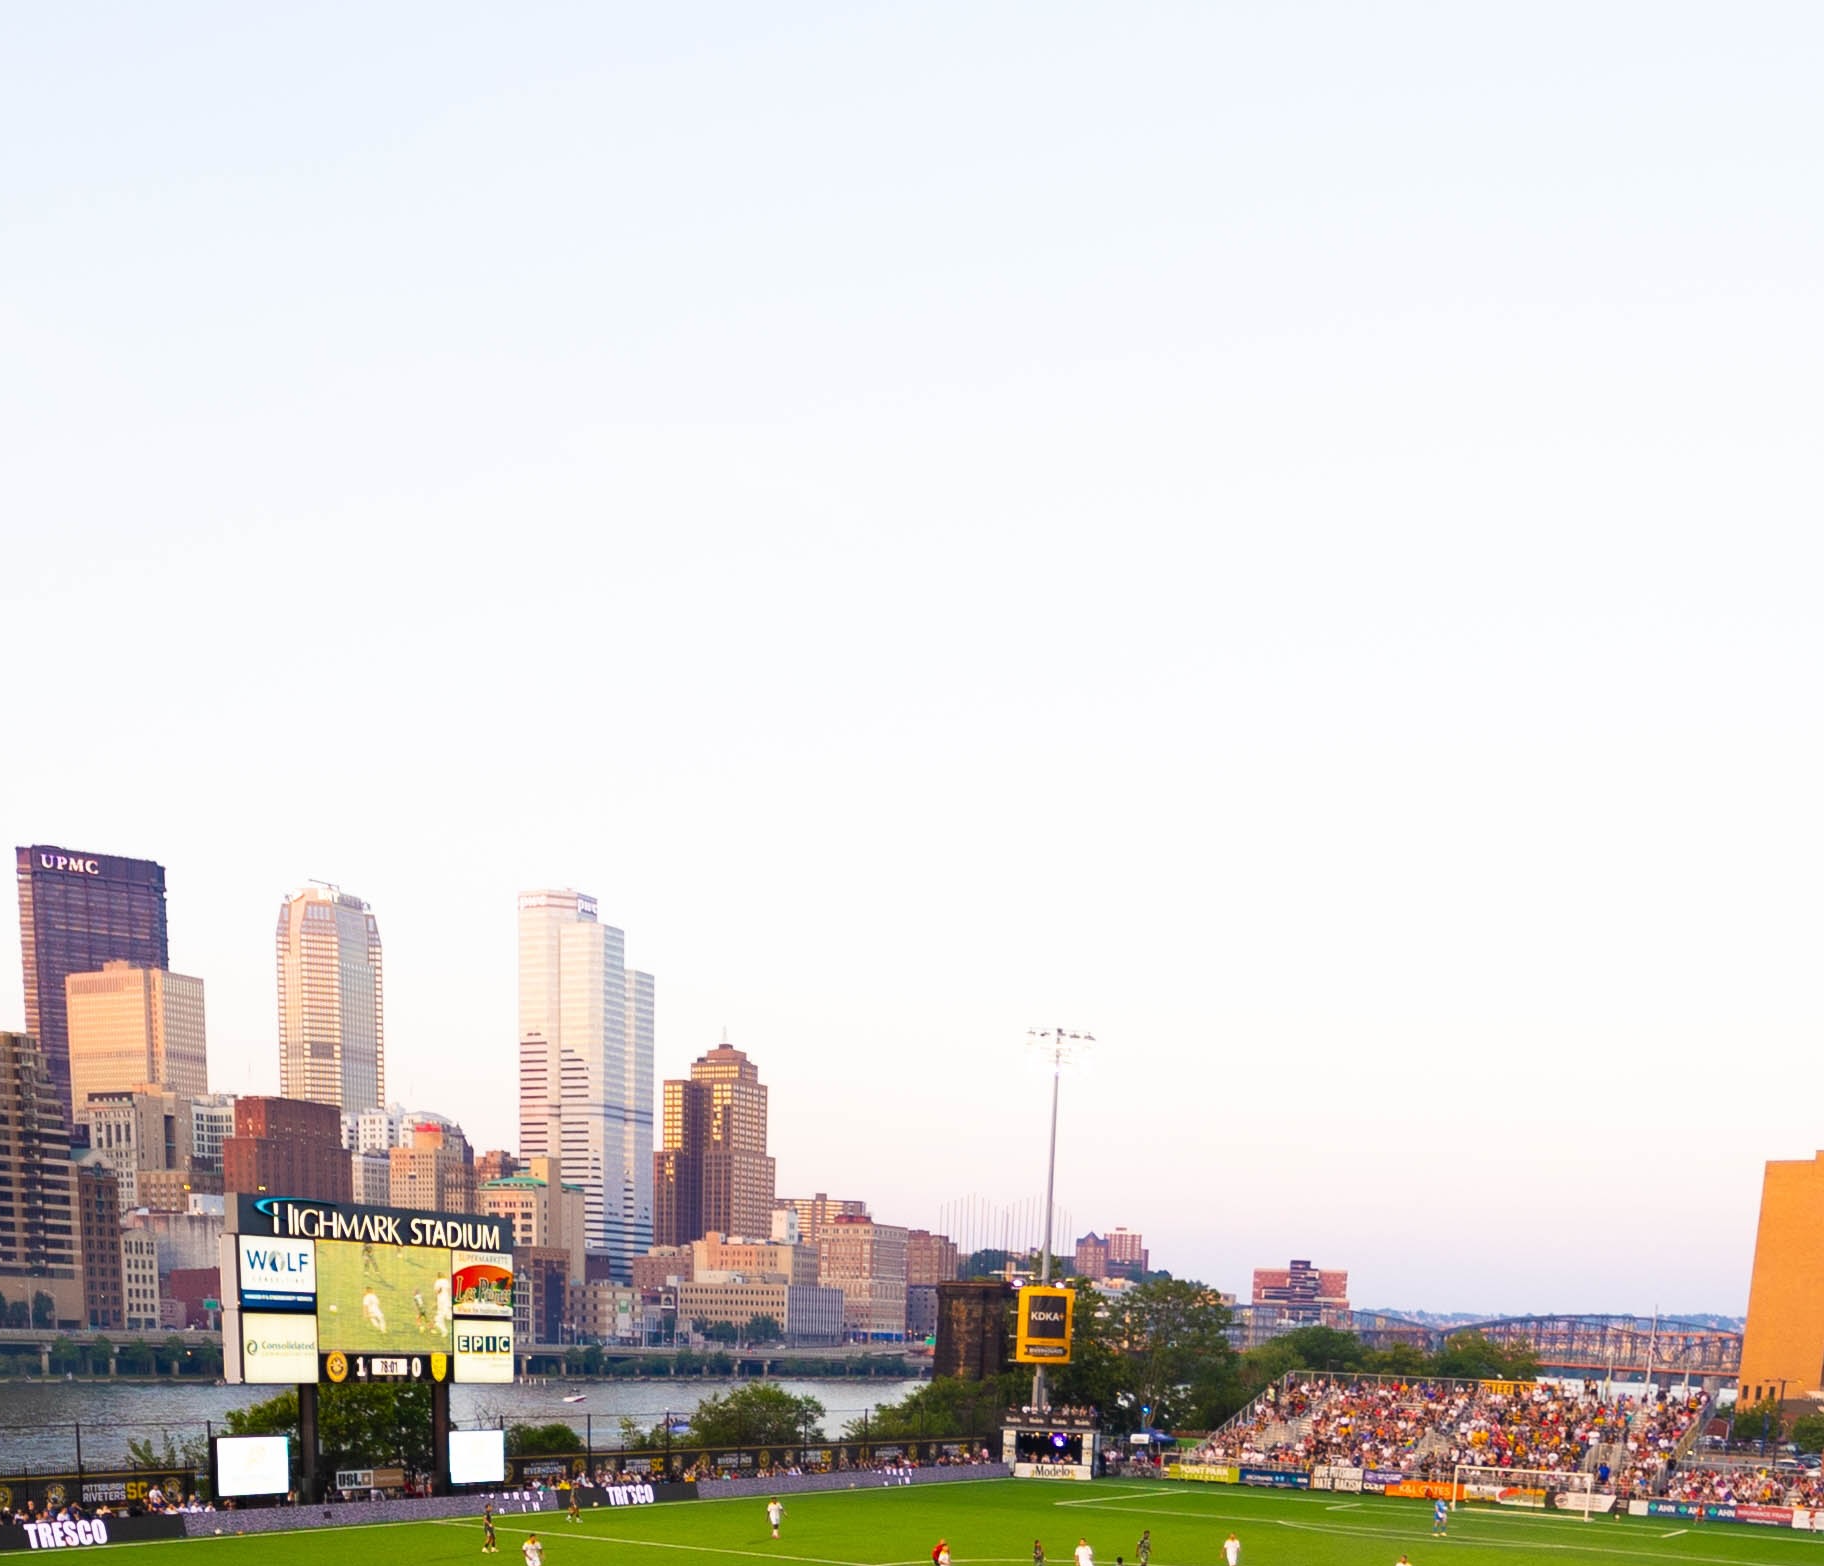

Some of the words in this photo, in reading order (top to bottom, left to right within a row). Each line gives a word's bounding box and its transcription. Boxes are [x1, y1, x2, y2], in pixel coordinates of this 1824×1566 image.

[40, 853, 99, 875] UPMC
[271, 1200, 403, 1246] HIGHMARK
[410, 1217, 500, 1251] STADIUM
[246, 1248, 309, 1273] WOLF
[261, 1340, 315, 1351] Consolidated
[458, 1335, 510, 1353] EPIC
[356, 1357, 366, 1376] 1
[411, 1357, 422, 1377] 0
[1035, 1465, 1071, 1478] Modelo
[82, 1489, 127, 1503] RIVETERS
[126, 1481, 148, 1500] SC
[1658, 1504, 1675, 1513] AHN
[1717, 1509, 1735, 1518] AHN
[23, 1518, 108, 1549] TRESCO
